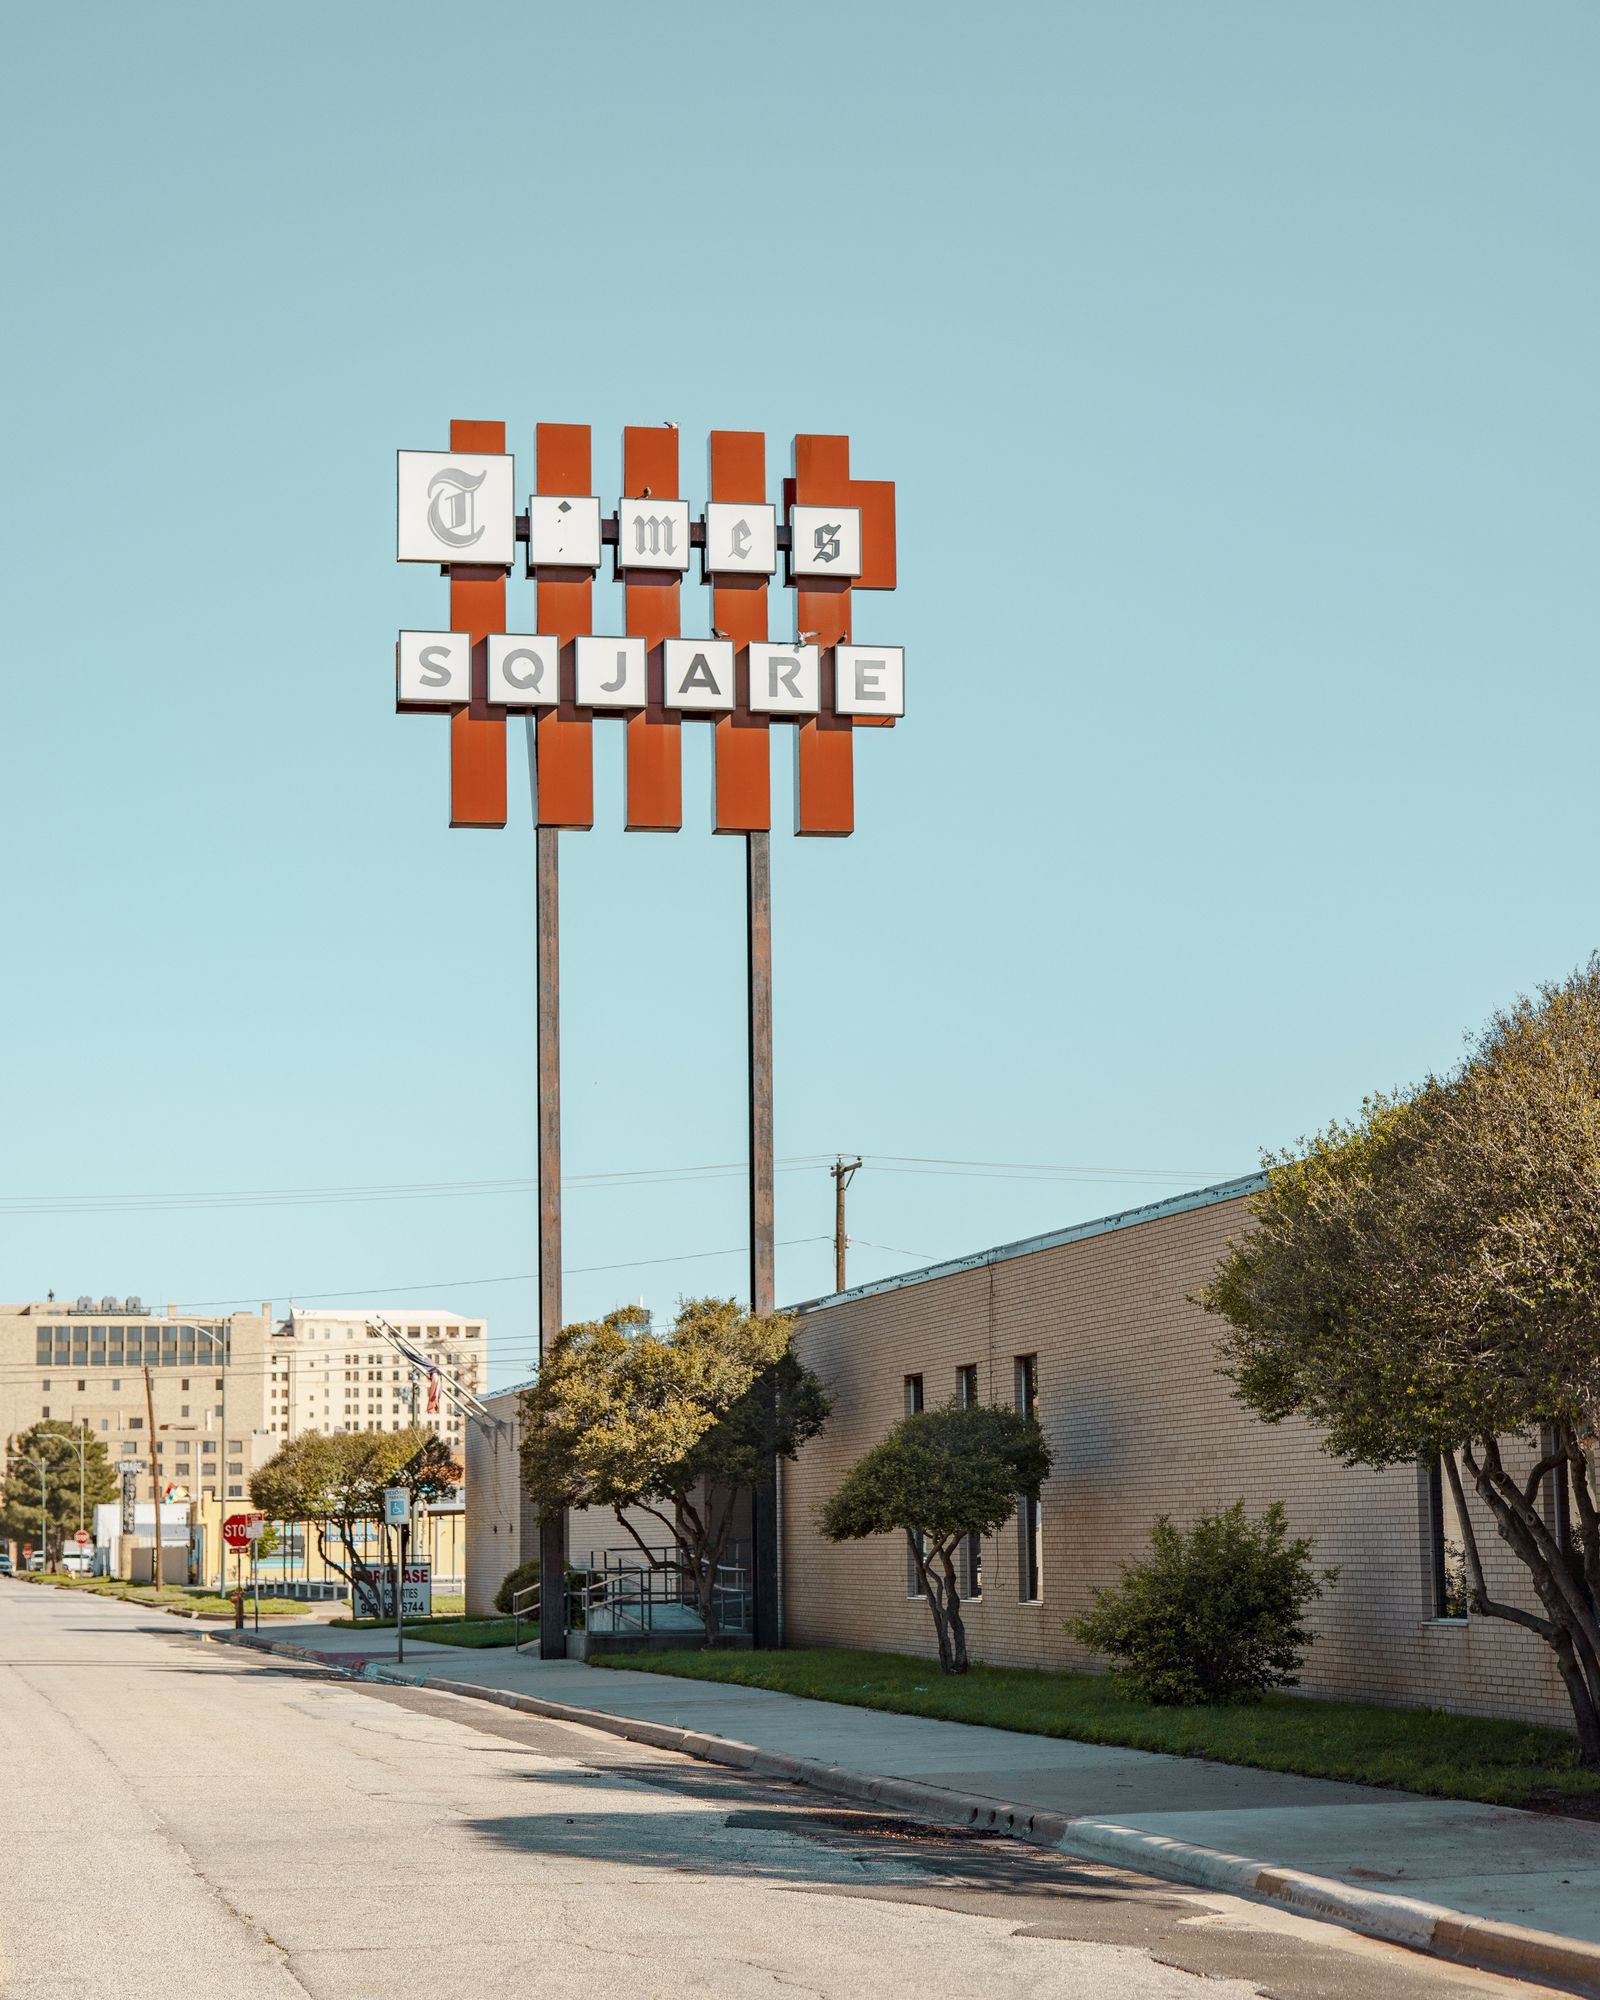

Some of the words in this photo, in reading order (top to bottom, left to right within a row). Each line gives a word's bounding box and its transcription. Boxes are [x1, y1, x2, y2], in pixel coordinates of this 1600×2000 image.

[426, 467, 842, 563] Tmes
[224, 1524, 246, 1537] STO
[386, 1569, 429, 1584] LASE
